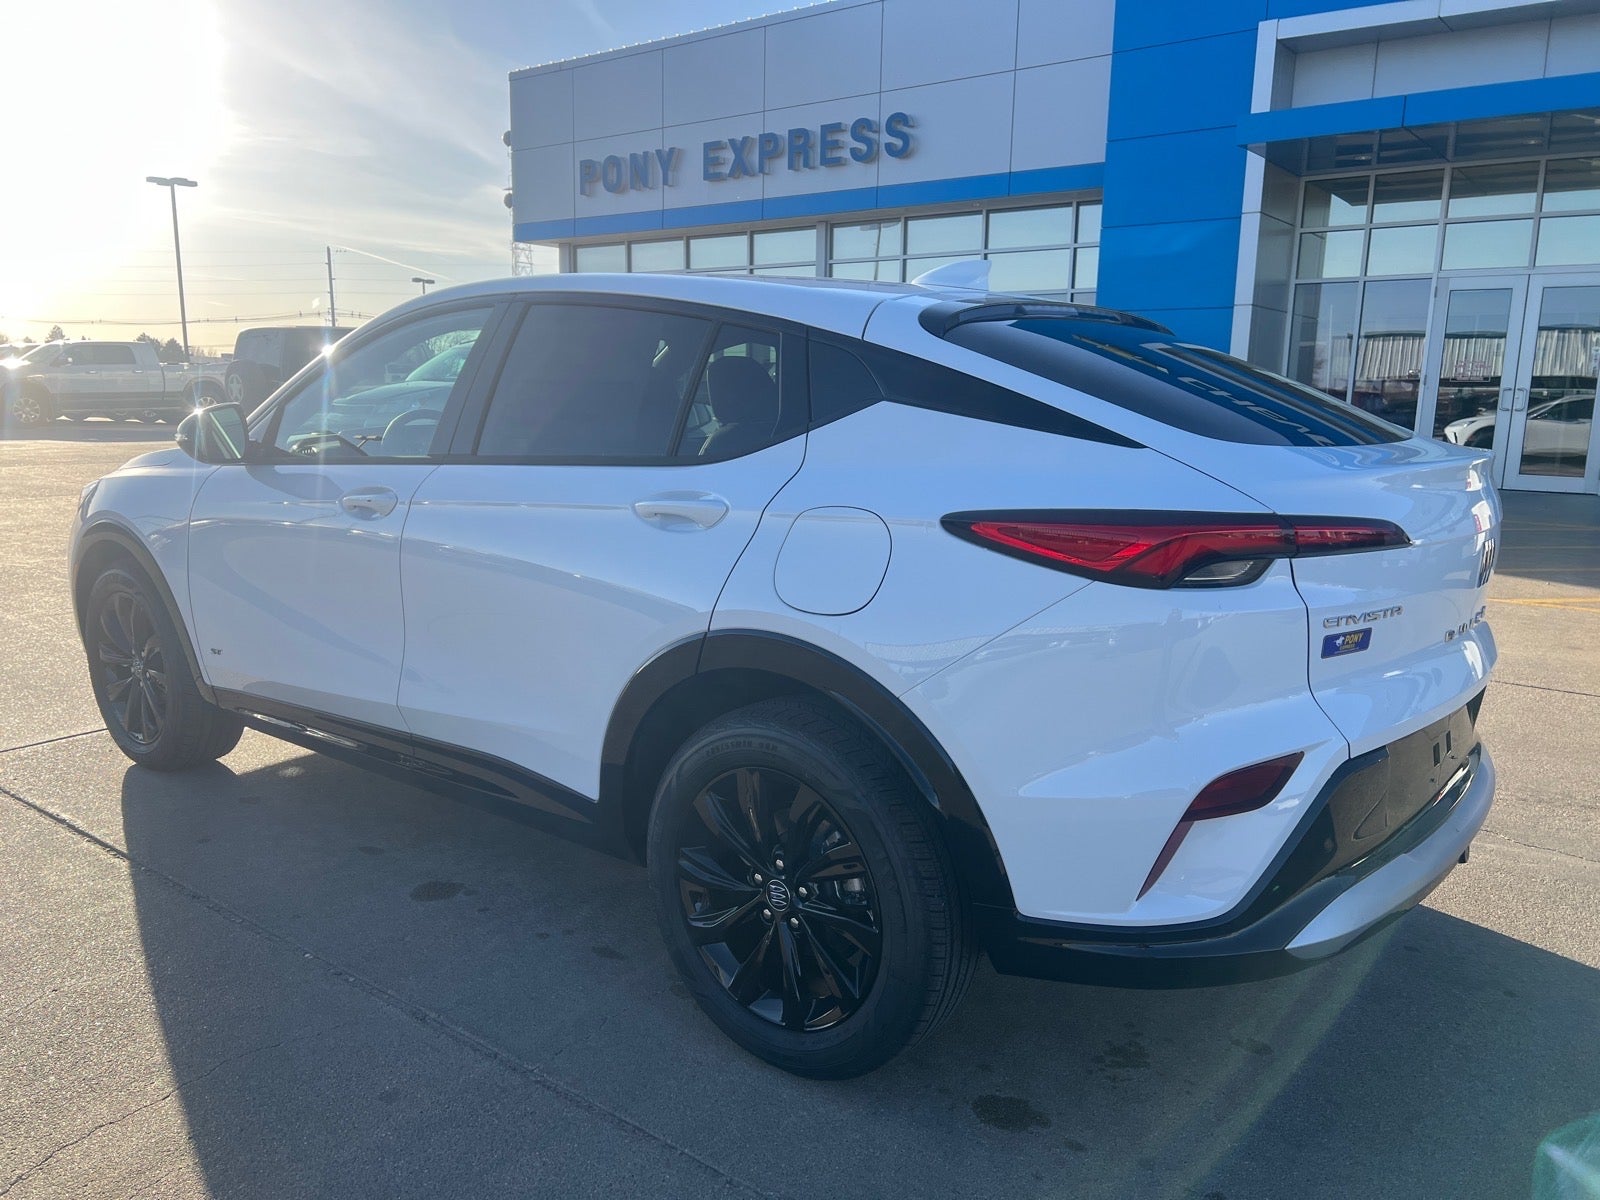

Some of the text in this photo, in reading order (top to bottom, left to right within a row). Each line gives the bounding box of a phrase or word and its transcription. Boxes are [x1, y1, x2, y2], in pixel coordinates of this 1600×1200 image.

[579, 111, 915, 197] PONY EXPRESS
[1323, 605, 1404, 629] ENVISTA
[1344, 632, 1364, 645] PONY
